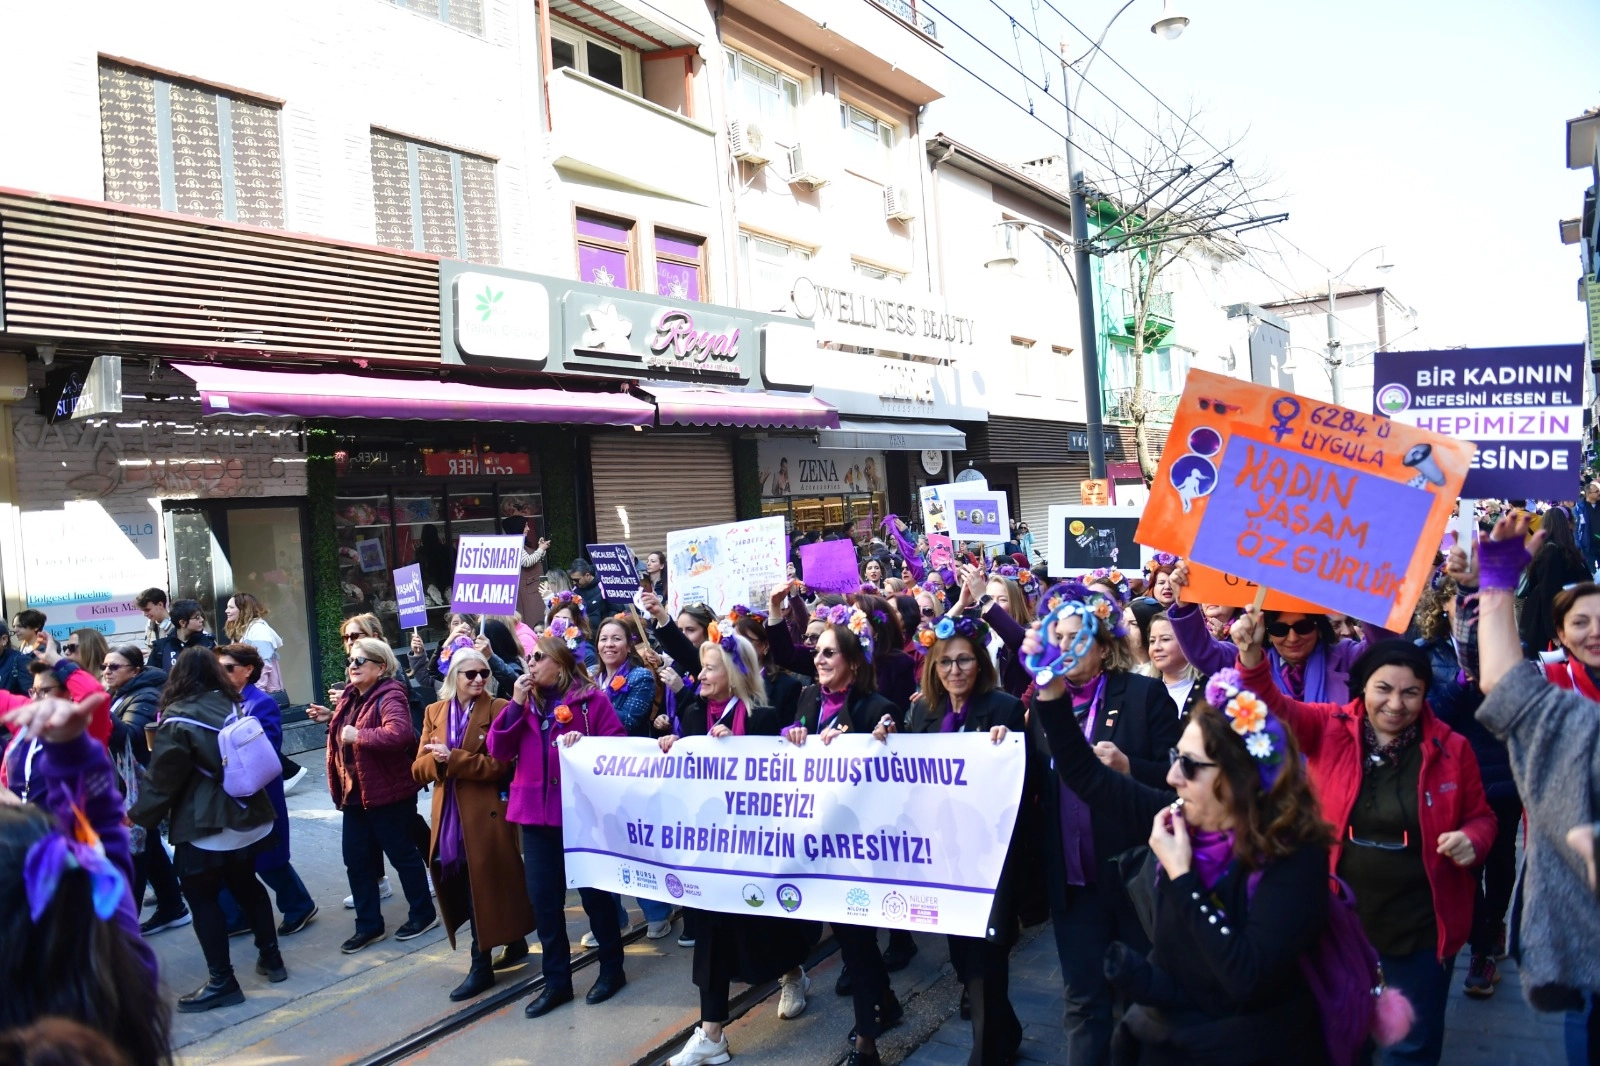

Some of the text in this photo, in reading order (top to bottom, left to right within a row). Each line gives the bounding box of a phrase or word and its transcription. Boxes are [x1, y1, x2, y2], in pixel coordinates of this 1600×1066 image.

[813, 284, 975, 346] WELLNESS BEAUTY
[652, 310, 741, 362] Royal
[1416, 364, 1572, 387] BİR KADININ
[1415, 391, 1572, 407] NEFESİNİ KESEN EL
[1416, 411, 1570, 435] HEPİMİZİN
[1302, 438, 1383, 477] UYGULA
[1469, 445, 1569, 470] ESİNDE
[799, 459, 840, 482] ZENA
[1234, 446, 1357, 511] KADIN
[1246, 494, 1369, 549] YAŞAM
[459, 542, 520, 569] İSTİSMARI
[595, 563, 622, 571] KARARLI
[1236, 522, 1408, 606] ÖZGÜRLÜK
[30, 593, 71, 605] Bölgesel
[396, 582, 415, 596] YAŞAM
[455, 582, 516, 605] AKLAMA!
[91, 606, 119, 616] Kalıcı
[593, 751, 968, 787] SAKLANDIĞIMIZ DEĞİL BULUŞTUĞUMUZ
[724, 788, 815, 819] YERDEYİZ!
[626, 818, 933, 865] BİZ BİRBİRİMİZİN ÇARESİYİZ!
[635, 869, 657, 880] BURSA
[909, 895, 939, 907] NİLÜFER
